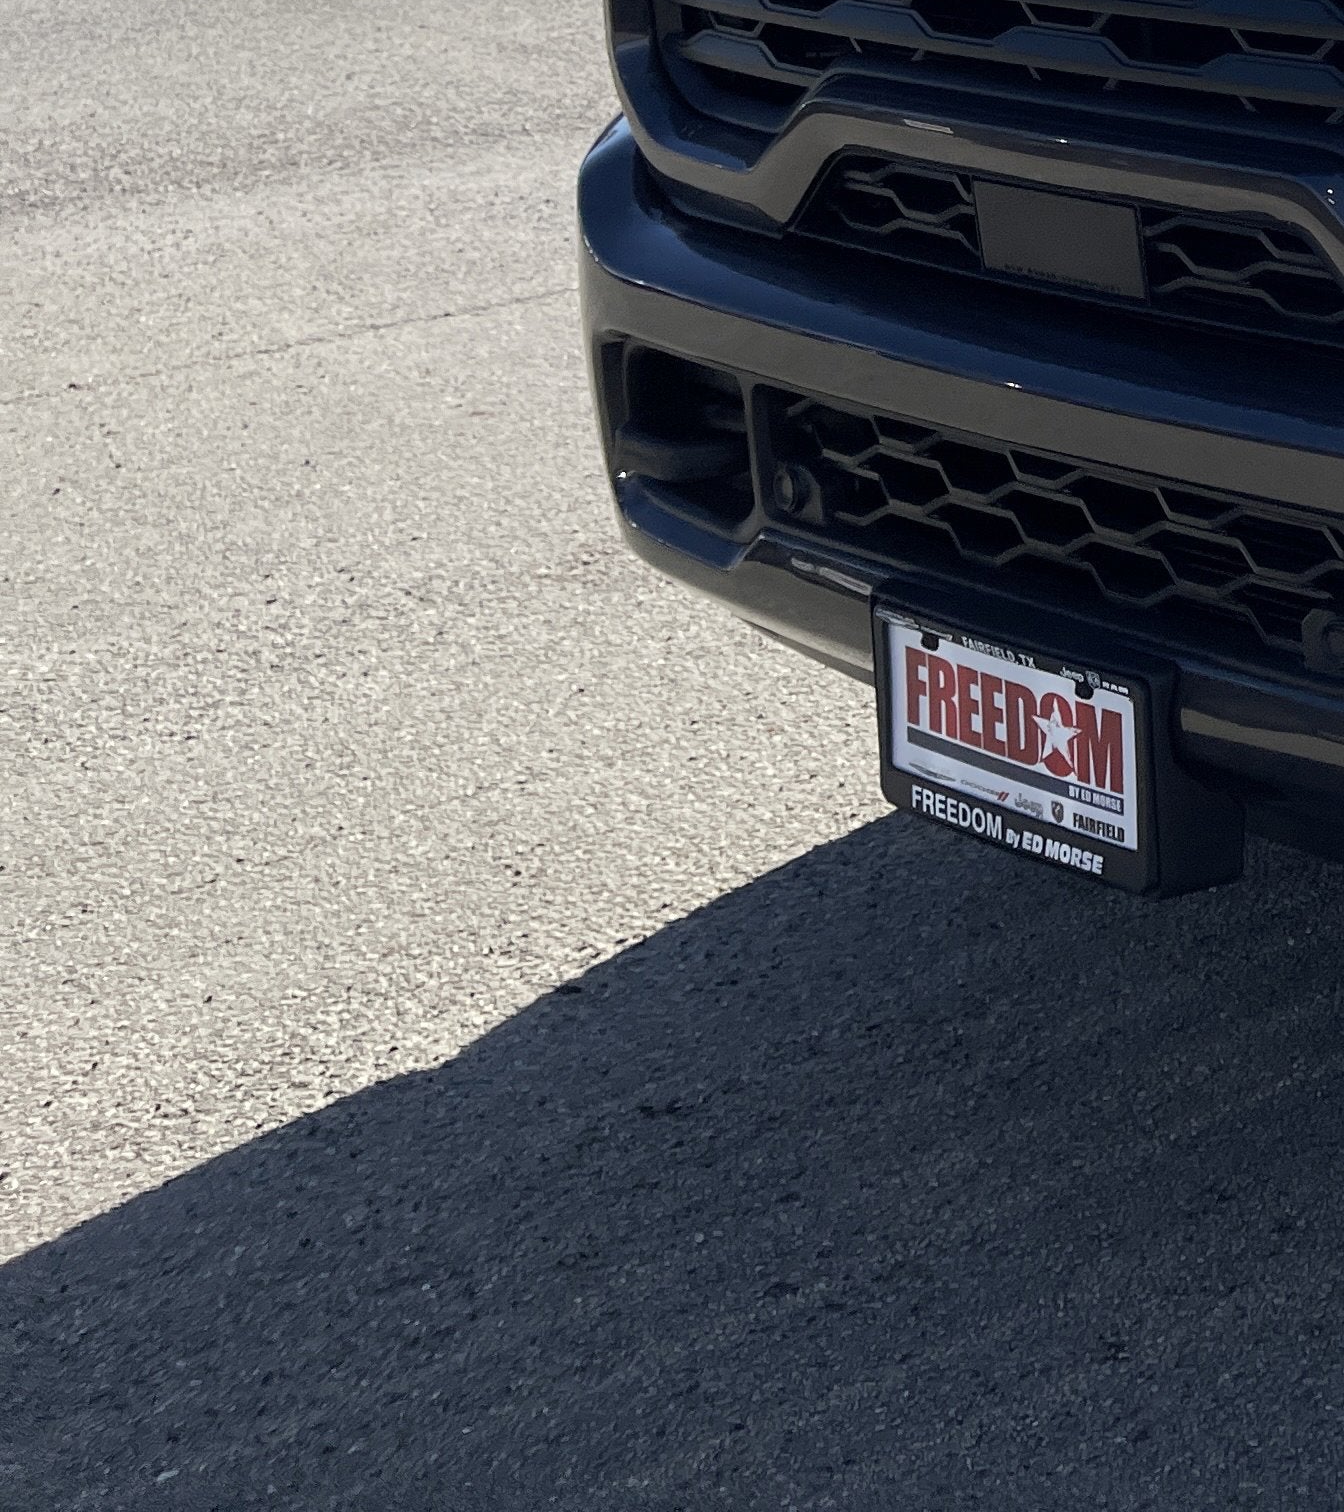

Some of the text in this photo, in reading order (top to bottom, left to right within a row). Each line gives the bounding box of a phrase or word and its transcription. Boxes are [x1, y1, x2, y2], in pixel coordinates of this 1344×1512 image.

[1018, 654, 1037, 669] TX
[1102, 681, 1129, 695] RAM
[905, 645, 1124, 795] FREEDOM
[1068, 785, 1122, 813] BY ED MORSE
[911, 784, 1003, 841] FREEDOM
[1022, 830, 1043, 853] ED
[1044, 838, 1105, 875] MORSE
[1072, 813, 1125, 843] FAIRFIELD
